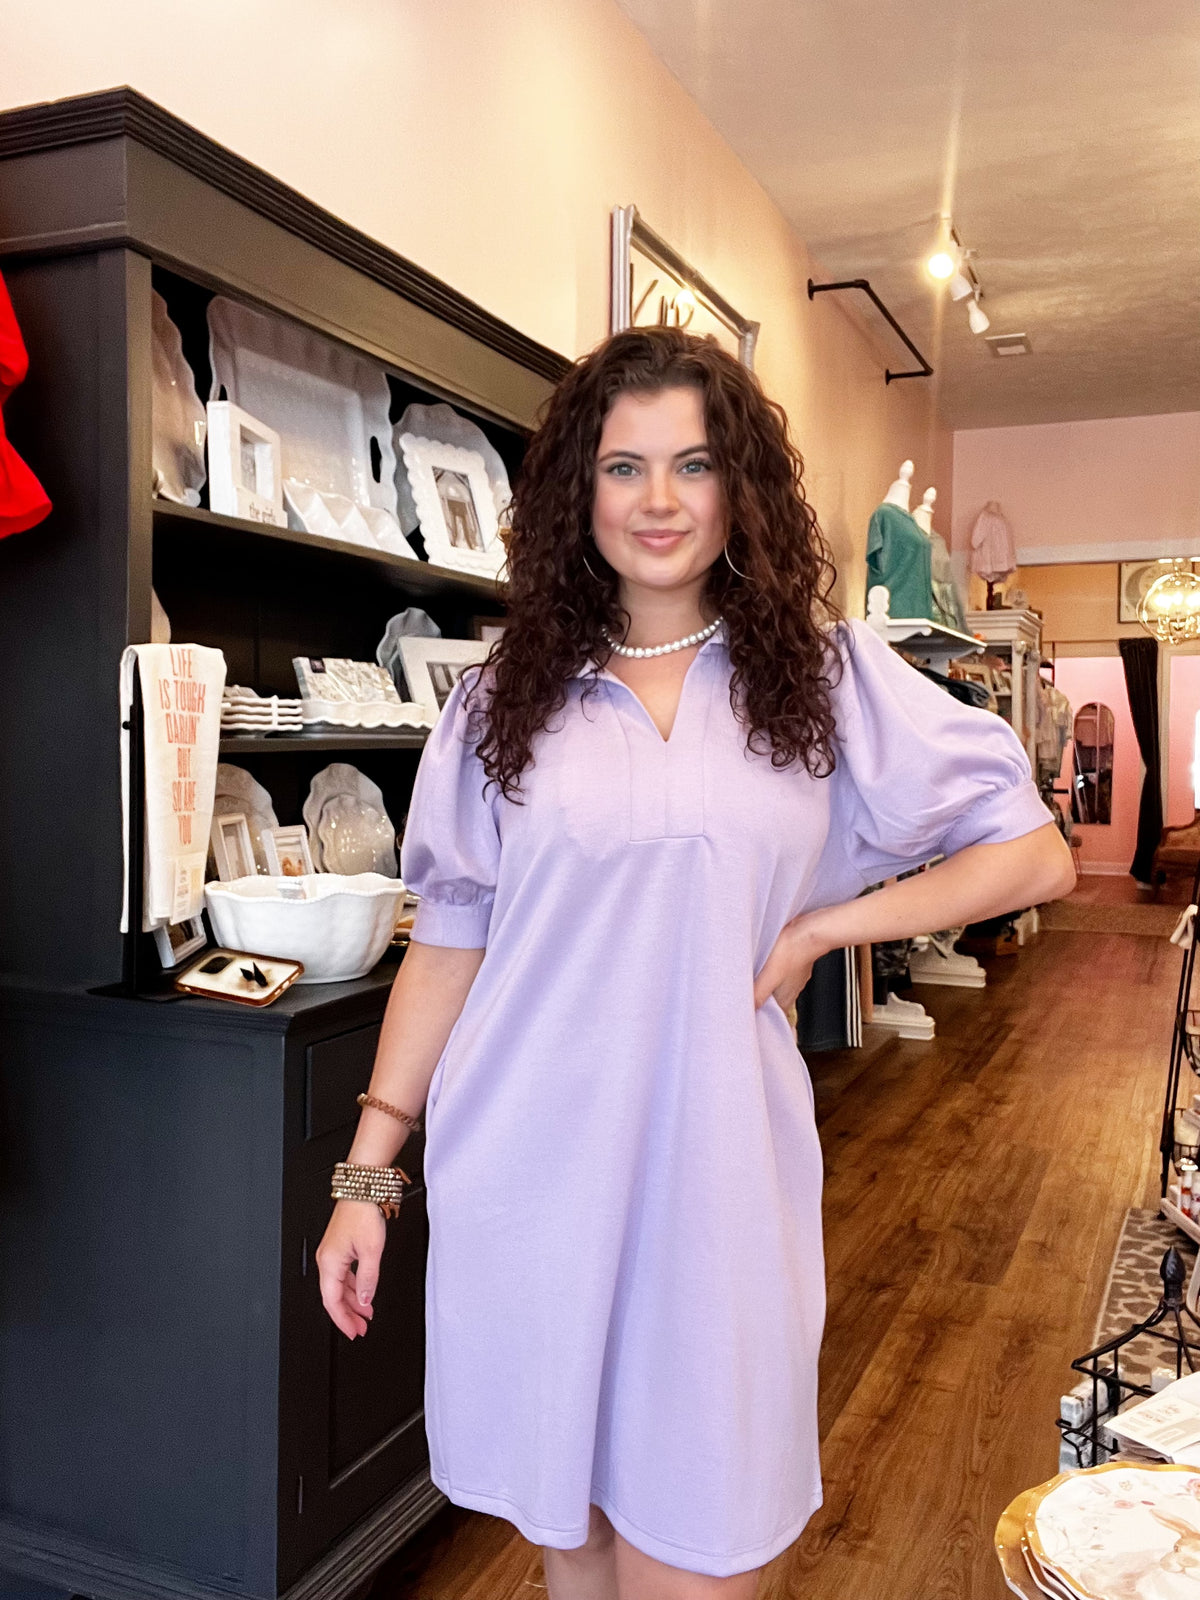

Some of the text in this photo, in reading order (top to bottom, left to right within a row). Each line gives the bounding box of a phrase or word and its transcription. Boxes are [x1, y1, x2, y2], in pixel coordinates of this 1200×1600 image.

[169, 646, 193, 679] LIFE
[158, 679, 207, 714] IS TOUGH
[177, 747, 191, 778] BUT
[172, 781, 196, 813] SO ARE
[177, 815, 192, 845] YOU
